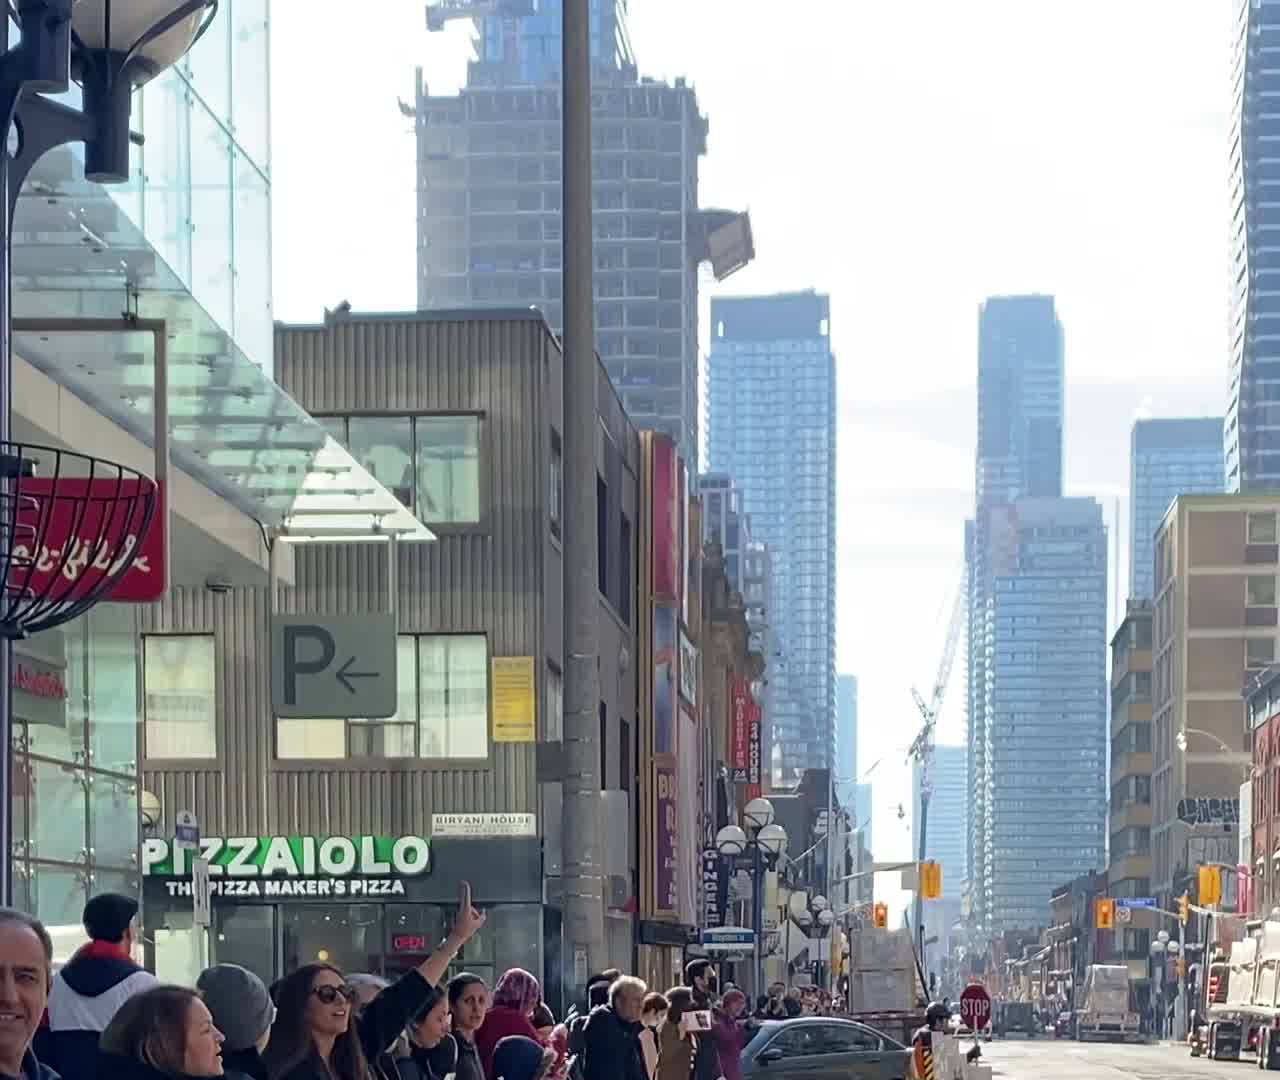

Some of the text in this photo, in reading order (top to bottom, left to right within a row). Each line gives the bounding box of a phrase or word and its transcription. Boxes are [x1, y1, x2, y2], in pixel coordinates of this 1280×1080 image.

[283, 625, 336, 705] P
[141, 834, 431, 876] PIZZAIOLO
[165, 880, 196, 897] TH
[207, 880, 260, 896] PIZZA
[265, 877, 346, 896] MAKER'S
[350, 879, 405, 895] PIZZA
[962, 998, 990, 1017] STOP
